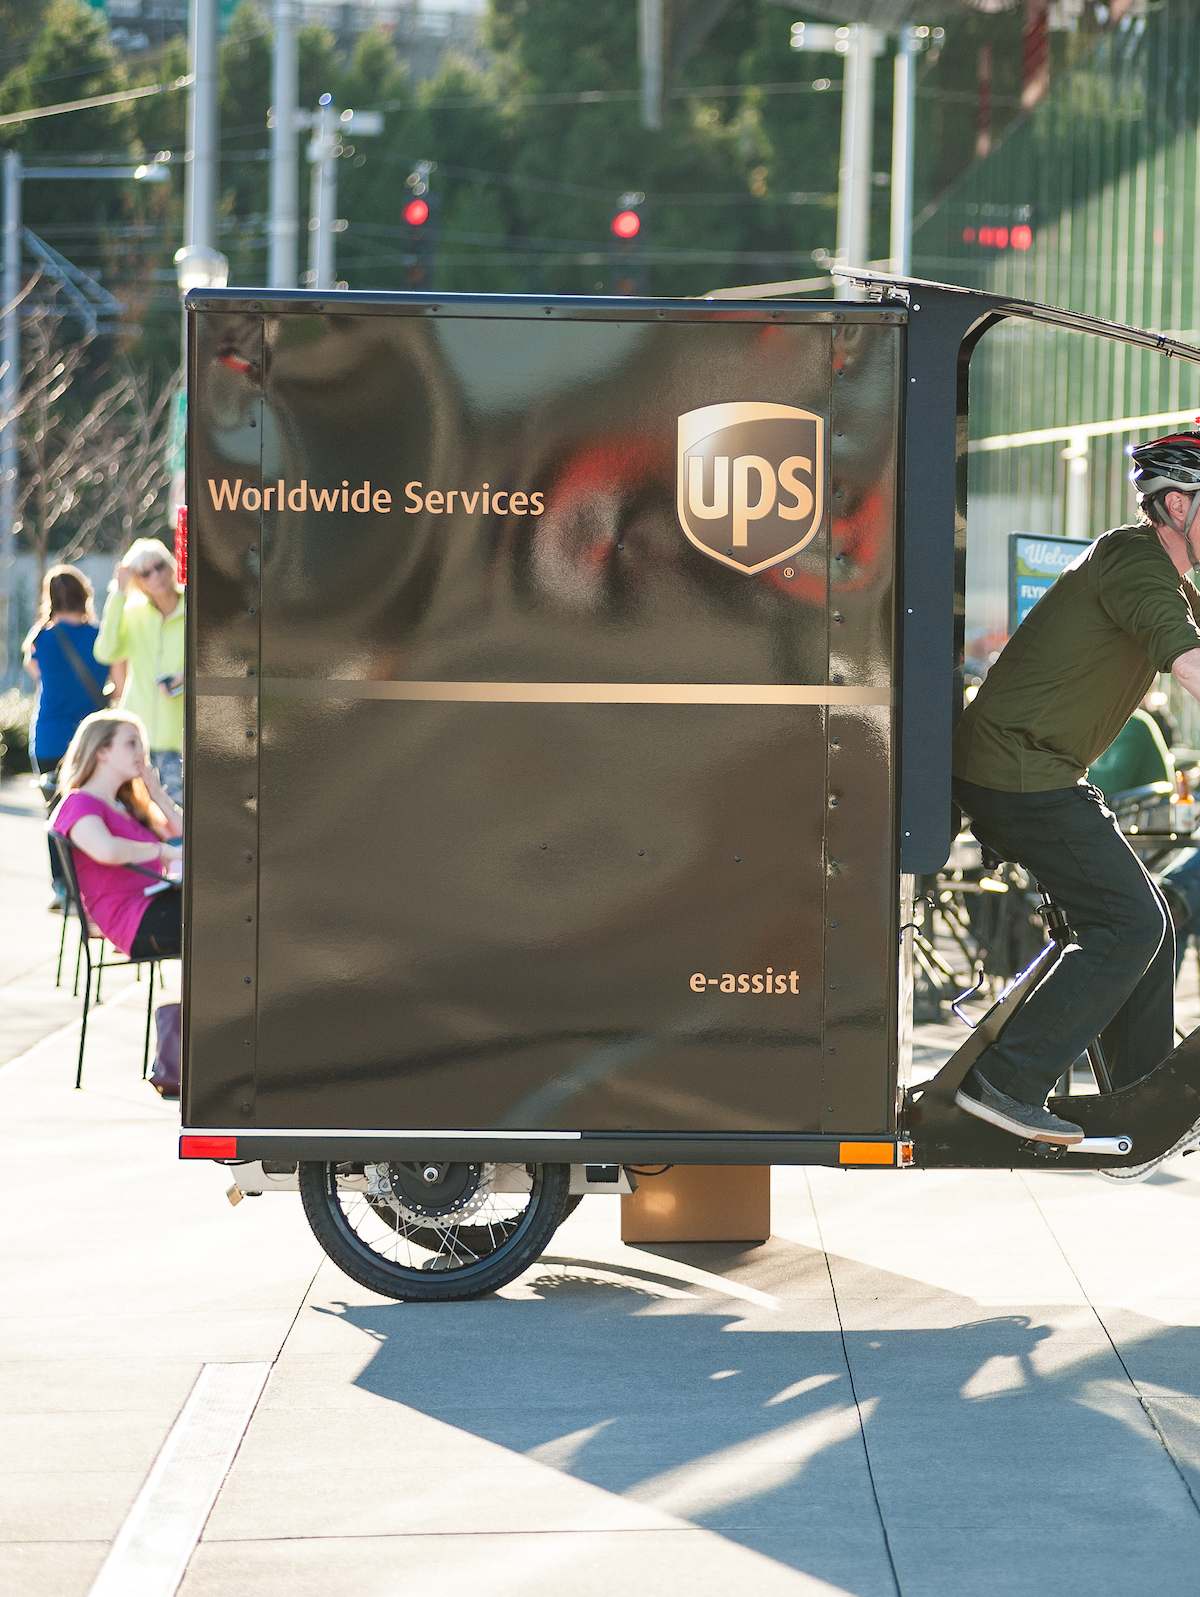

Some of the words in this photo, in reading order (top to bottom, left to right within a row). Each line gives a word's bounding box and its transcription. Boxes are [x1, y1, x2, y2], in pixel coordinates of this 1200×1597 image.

[207, 478, 392, 513] Worldwide
[404, 480, 545, 516] Services
[688, 454, 814, 547] ups
[1023, 542, 1080, 567] Welco
[689, 966, 800, 995] e-assist
